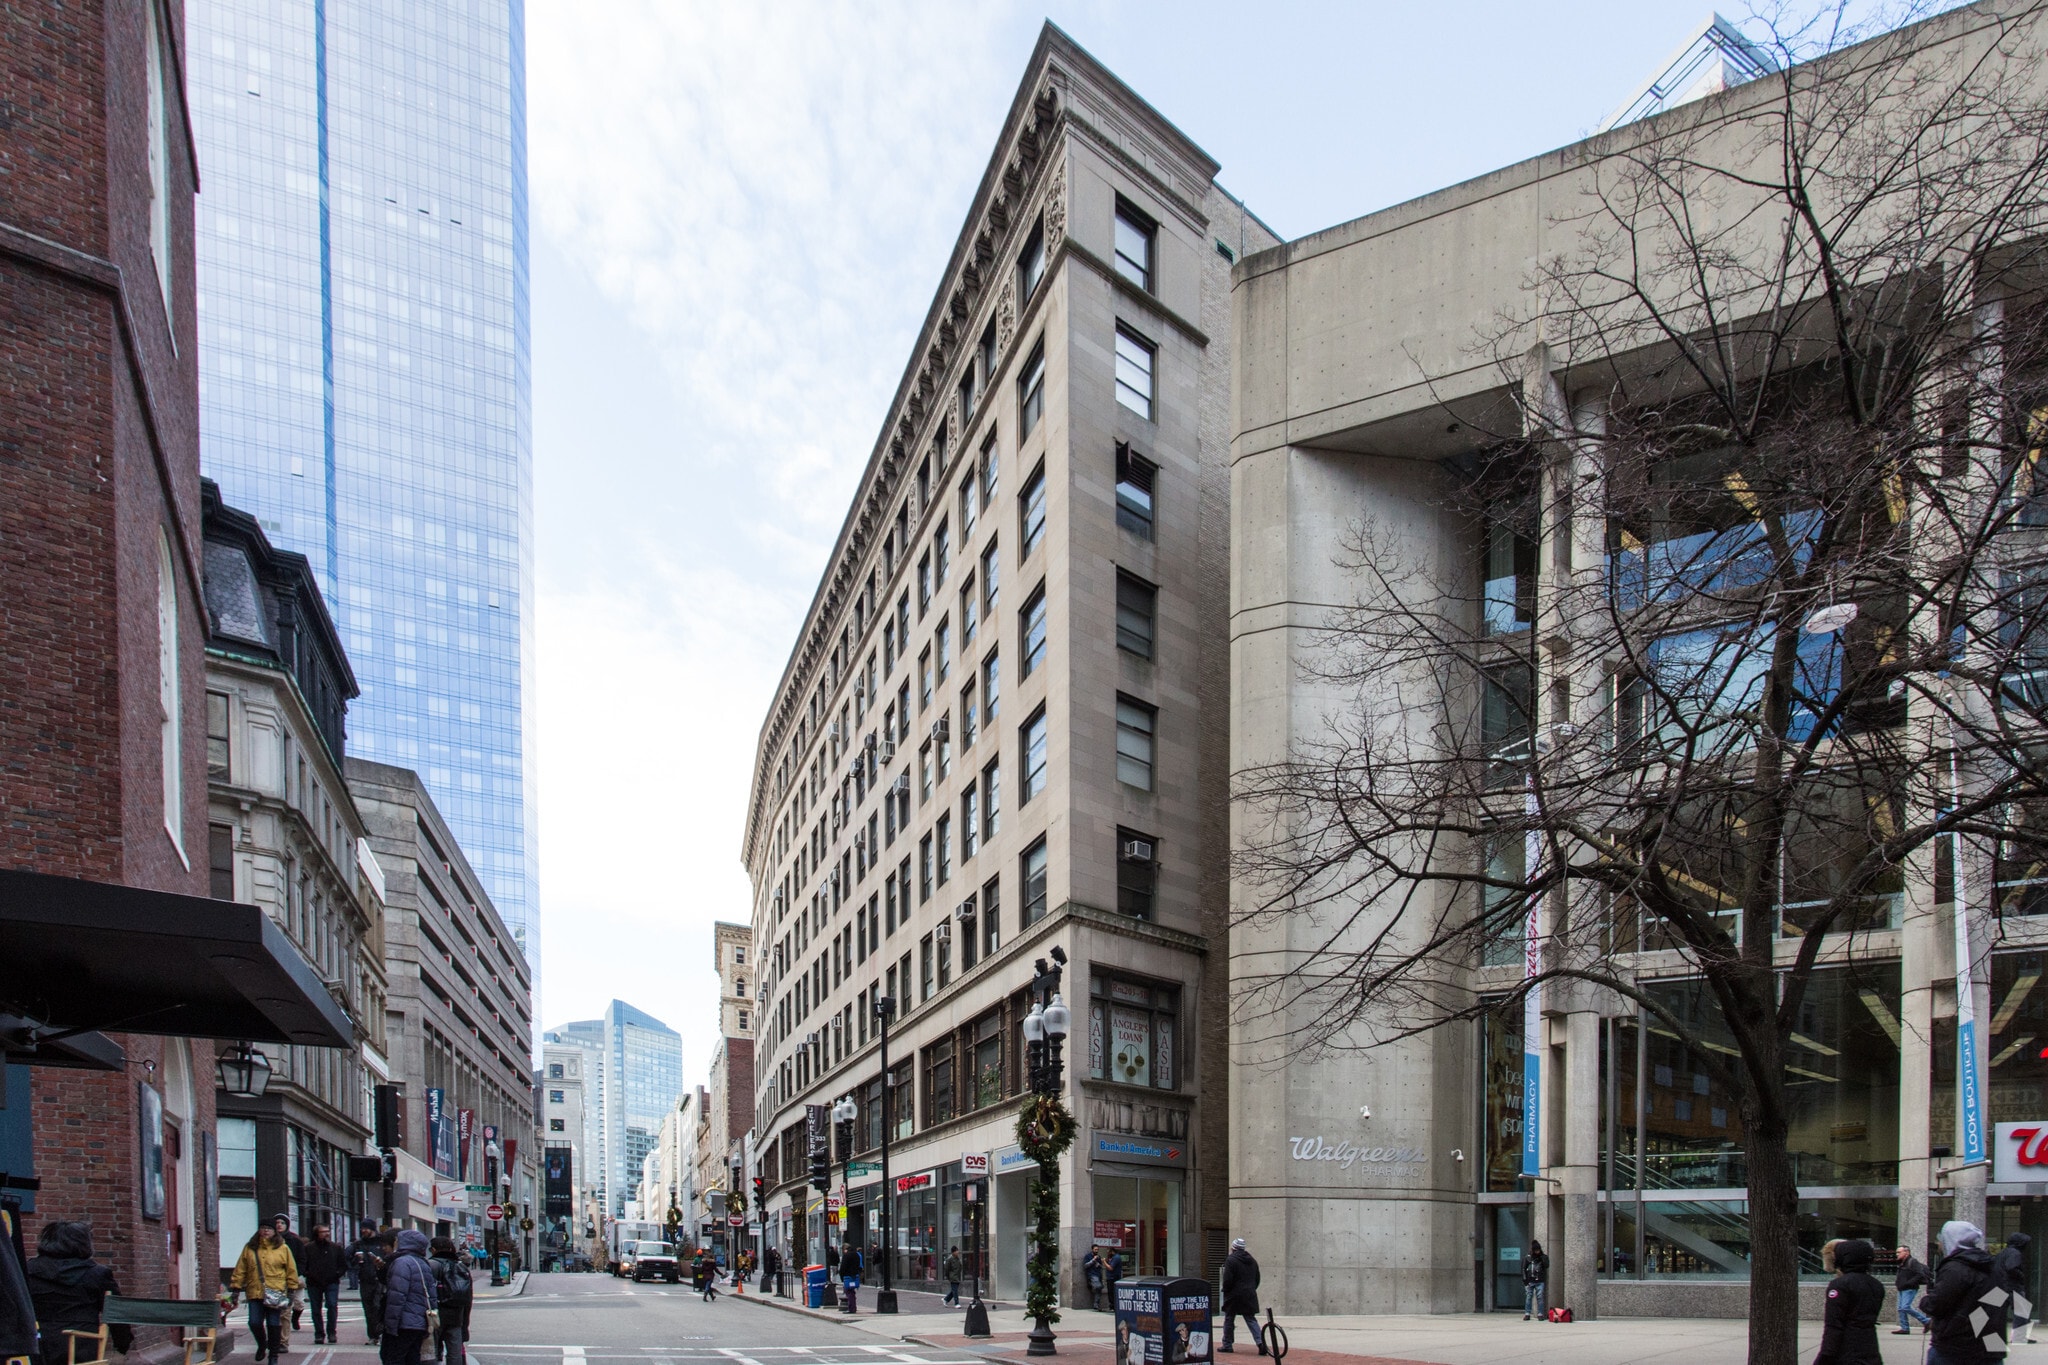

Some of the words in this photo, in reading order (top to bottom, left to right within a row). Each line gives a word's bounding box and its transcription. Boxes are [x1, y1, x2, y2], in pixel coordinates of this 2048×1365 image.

[1091, 1006, 1103, 1070] CASH
[1160, 1020, 1170, 1080] CASH
[429, 1089, 439, 1121] Marshalls
[1528, 1078, 1537, 1152] PHARMACY
[1968, 1114, 1978, 1154] LOOK
[1099, 1140, 1120, 1152] Bank
[1120, 1142, 1129, 1153] of
[1129, 1143, 1161, 1157] America
[1289, 1136, 1428, 1170] Walgreens
[965, 1156, 986, 1166] CVS
[1001, 1155, 1012, 1165] Bank
[1012, 1153, 1017, 1163] of
[1361, 1166, 1427, 1178] PHARMACY
[1118, 1288, 1134, 1300] DUMP
[1135, 1289, 1147, 1301] THE
[1147, 1290, 1159, 1301] TEA
[1119, 1300, 1132, 1311] INTO
[1133, 1301, 1144, 1312] THE
[1145, 1301, 1158, 1313] SEA!
[1170, 1303, 1184, 1311] INTO
